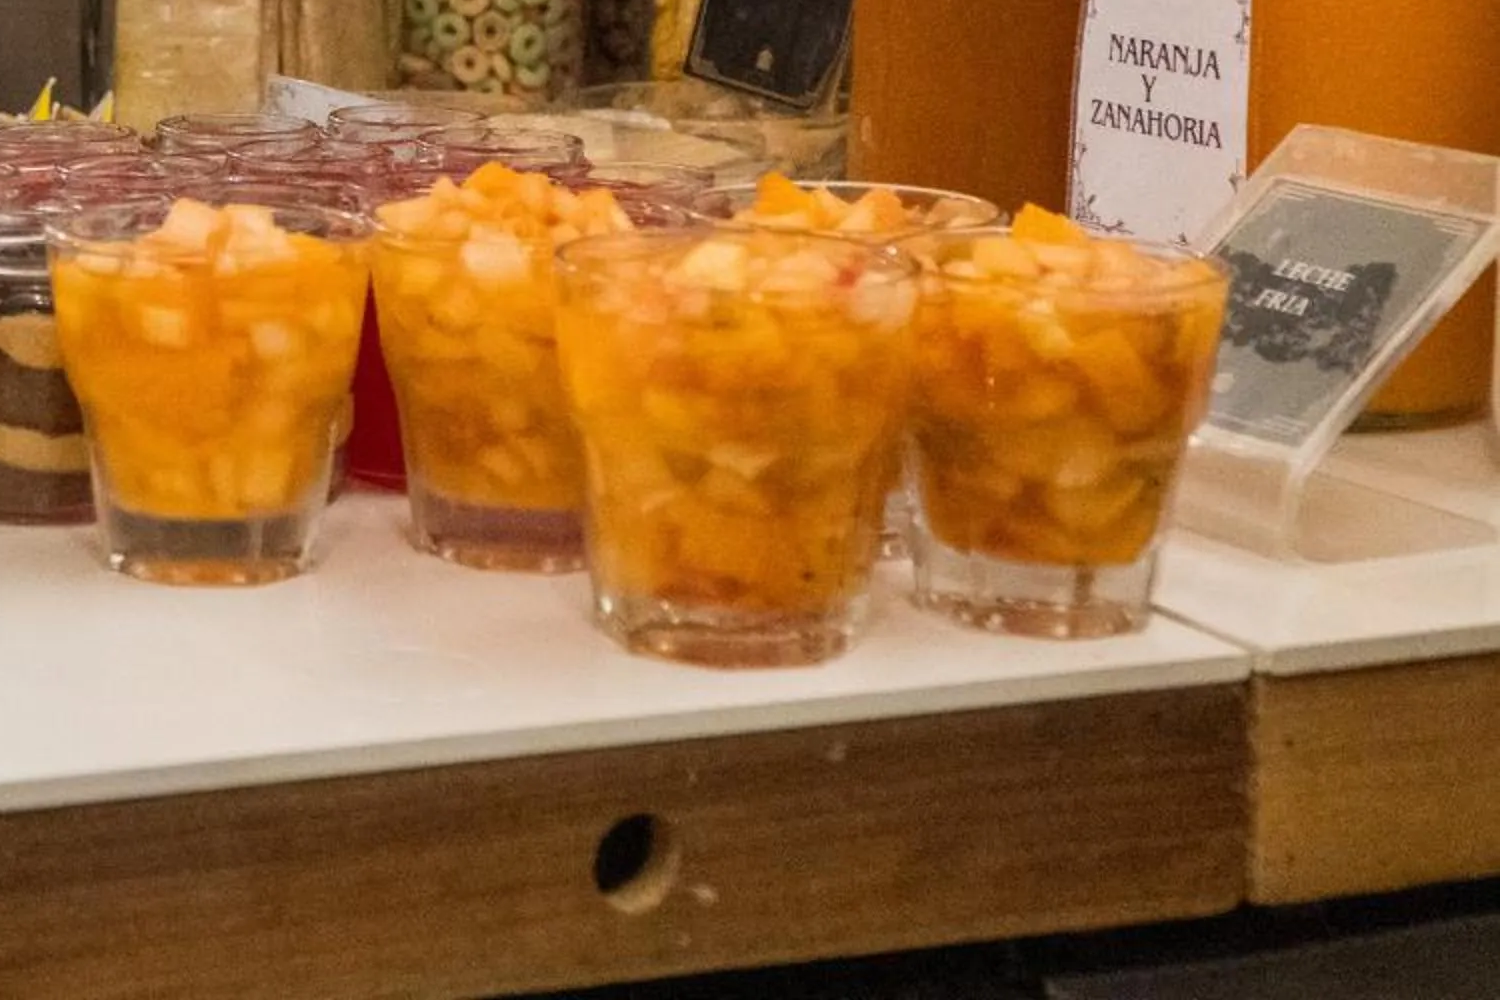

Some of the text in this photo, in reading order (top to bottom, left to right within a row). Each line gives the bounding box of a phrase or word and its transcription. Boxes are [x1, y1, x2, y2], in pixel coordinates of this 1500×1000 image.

[1108, 34, 1221, 79] NARANJA
[1141, 74, 1157, 103] Y
[1091, 99, 1222, 149] ZANAHORIA
[1271, 259, 1356, 292] LECHE
